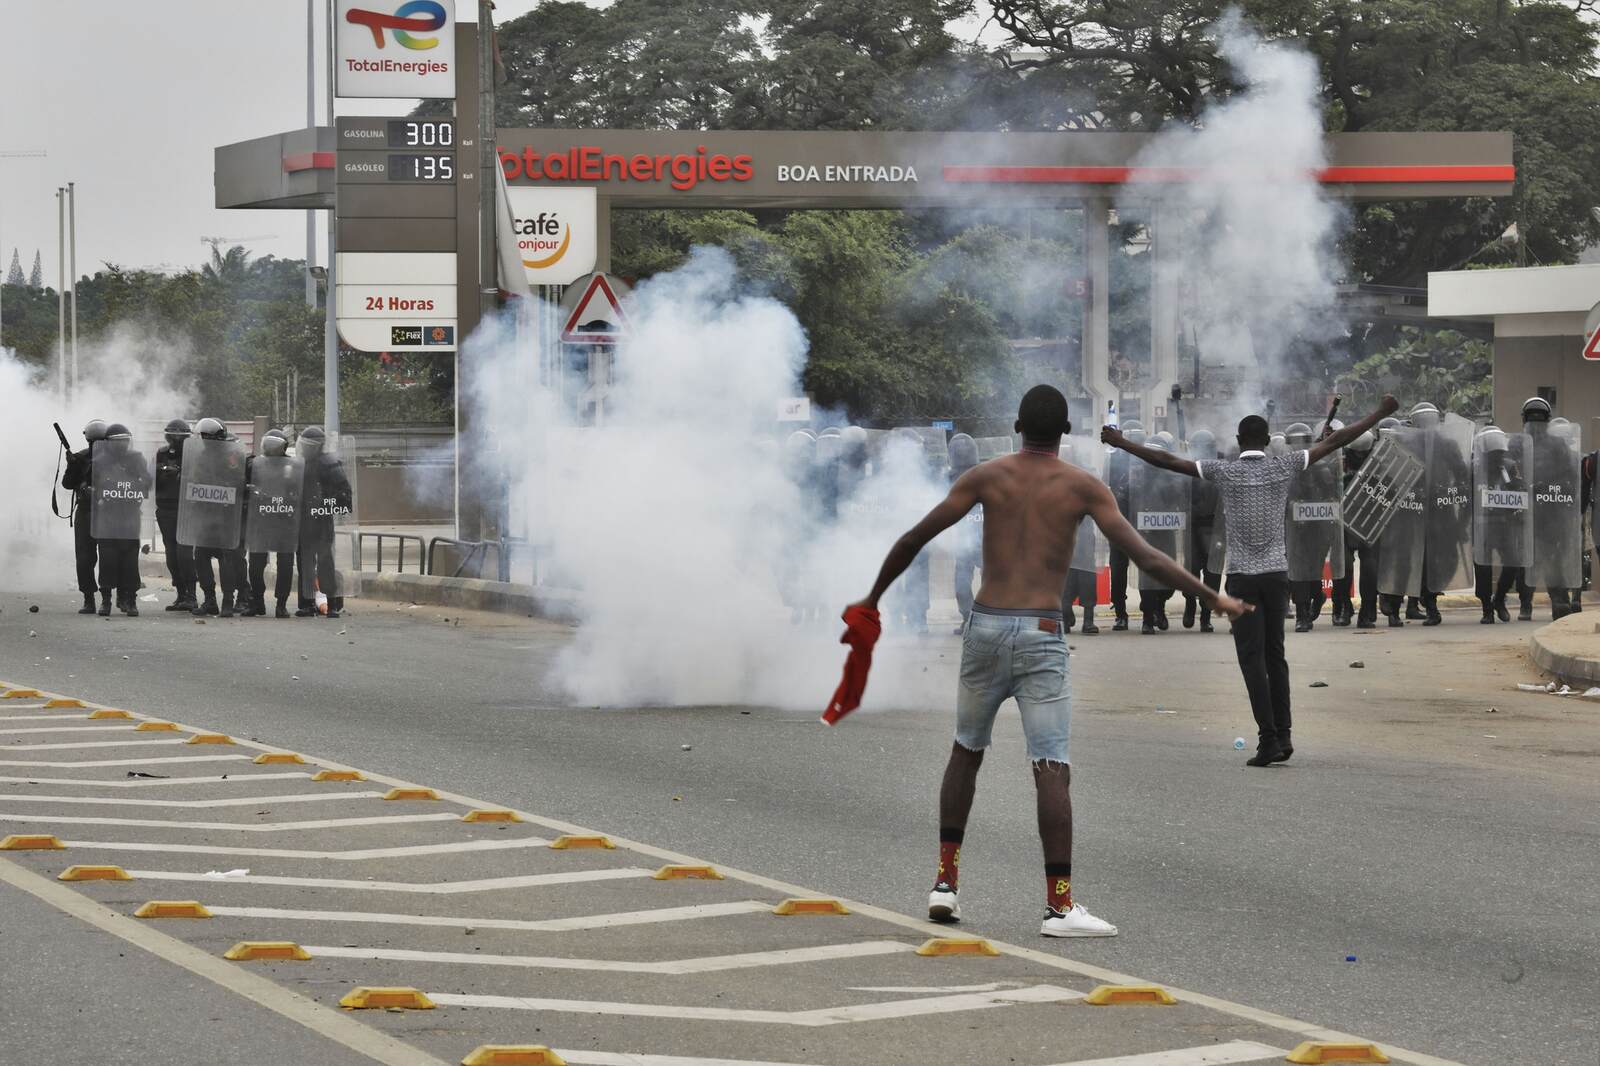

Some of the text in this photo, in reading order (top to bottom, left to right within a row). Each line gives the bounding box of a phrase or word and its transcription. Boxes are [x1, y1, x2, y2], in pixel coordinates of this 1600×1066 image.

[345, 59, 448, 76] TotalEnergies
[343, 123, 452, 146] GASOLINA 300
[414, 156, 452, 179] 135
[496, 146, 754, 191] otalEnergies
[777, 165, 918, 182] BOA ENTRADA
[513, 213, 559, 235] café
[518, 238, 559, 252] onjour
[1075, 281, 1086, 295] 5
[366, 297, 434, 310] 24 Horas
[406, 331, 422, 340] Flex
[102, 489, 145, 499] POLÍCIA
[191, 487, 229, 501] POLICIA
[1447, 487, 1458, 495] PIR
[1548, 485, 1561, 493] PIR
[323, 498, 337, 506] PIR
[1487, 494, 1523, 506] POLICIA
[1536, 492, 1574, 503] POLÍCIA
[259, 503, 294, 513] POLÍCIA
[310, 504, 350, 516] POLÍCIA
[1298, 505, 1334, 518] POLICIA
[1143, 514, 1180, 527] POLICIA
